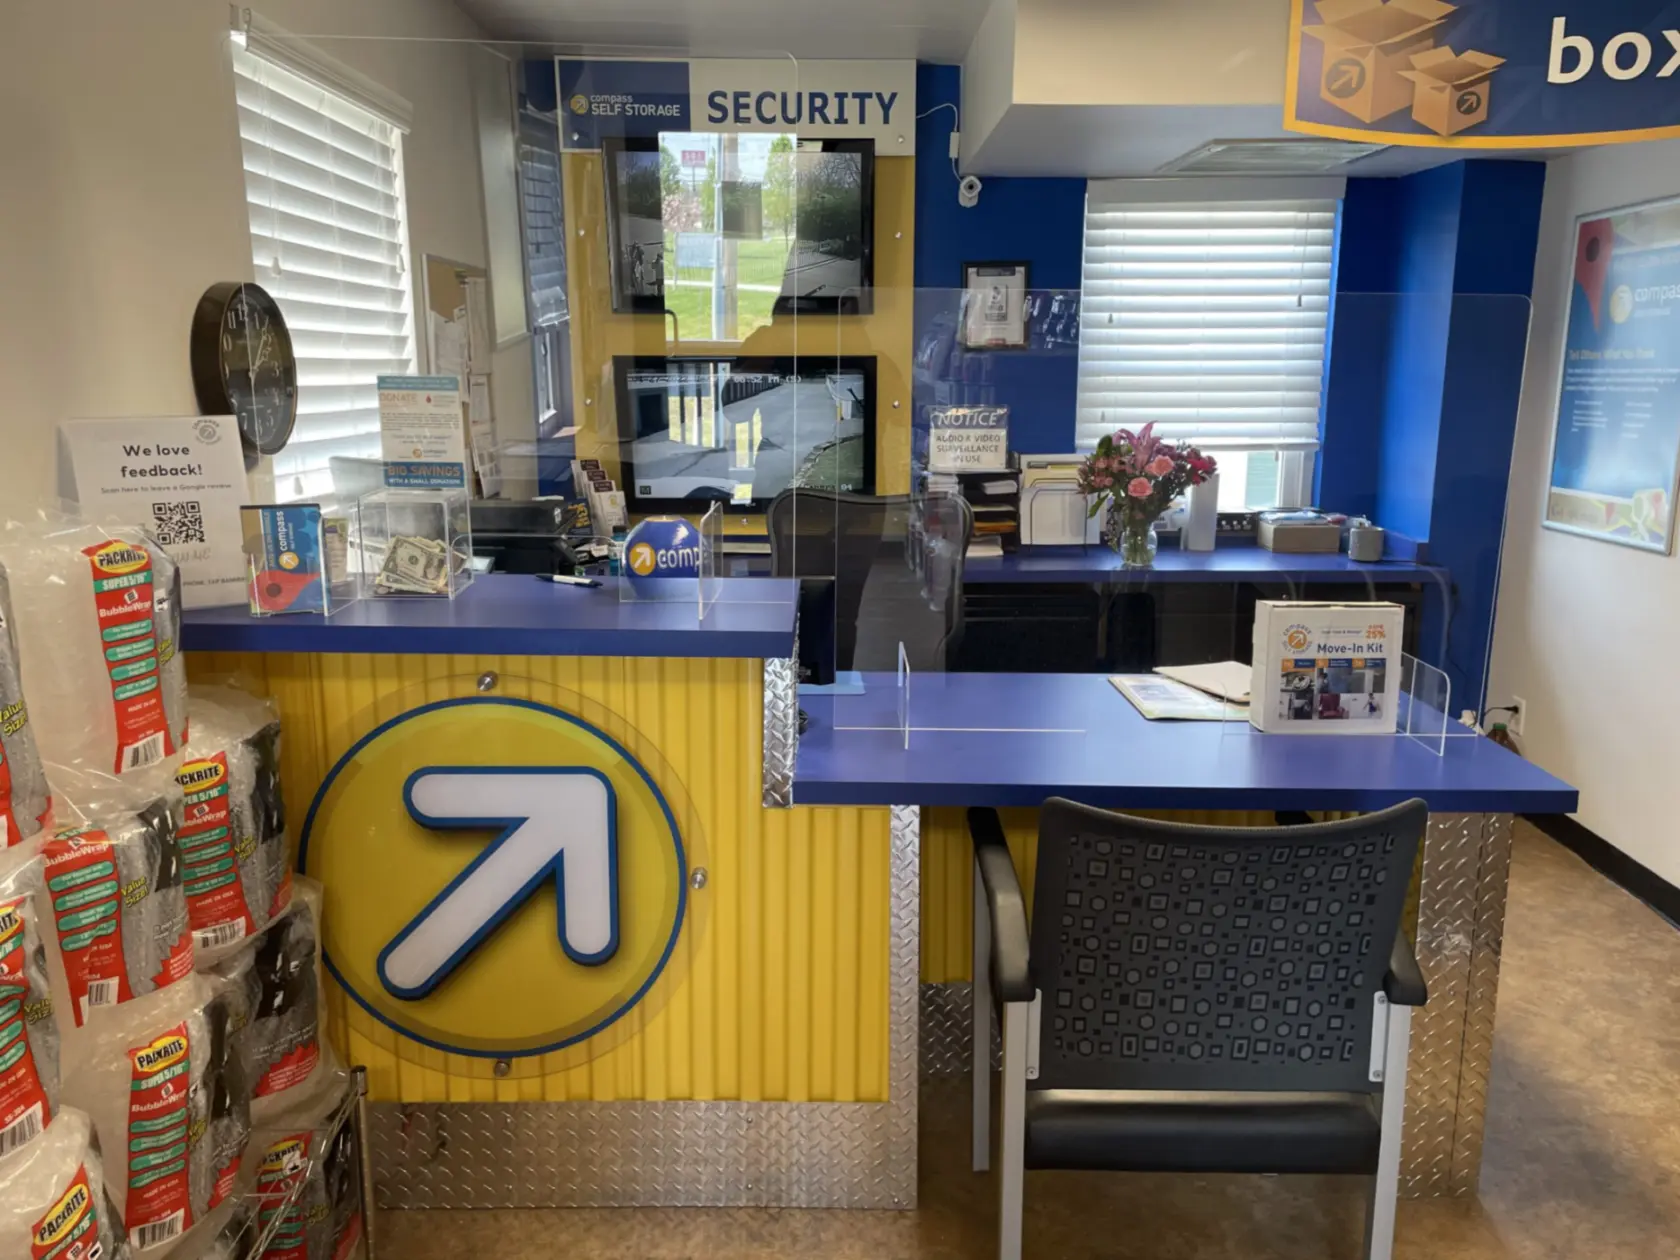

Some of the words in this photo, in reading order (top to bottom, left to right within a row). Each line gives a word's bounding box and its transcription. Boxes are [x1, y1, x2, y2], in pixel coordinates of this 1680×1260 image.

[590, 95, 633, 104] compass
[591, 103, 622, 116] SELF
[624, 104, 681, 117] STORAGE
[708, 90, 898, 126] SECURITY
[937, 411, 998, 427] NOTICE
[974, 434, 1001, 442] VIDEO
[122, 444, 152, 457] We
[156, 444, 191, 456] love
[936, 444, 999, 453] SURVEILLANCE
[965, 455, 981, 463] USE
[120, 463, 203, 478] feedback!
[388, 465, 407, 476] BIG
[410, 464, 461, 477] SAVINGS
[179, 484, 206, 492] Google
[276, 511, 288, 551] compass
[1317, 642, 1364, 654] Move-In
[1366, 642, 1383, 654] Kit
[120, 876, 147, 897] Value
[125, 885, 150, 909] Size!
